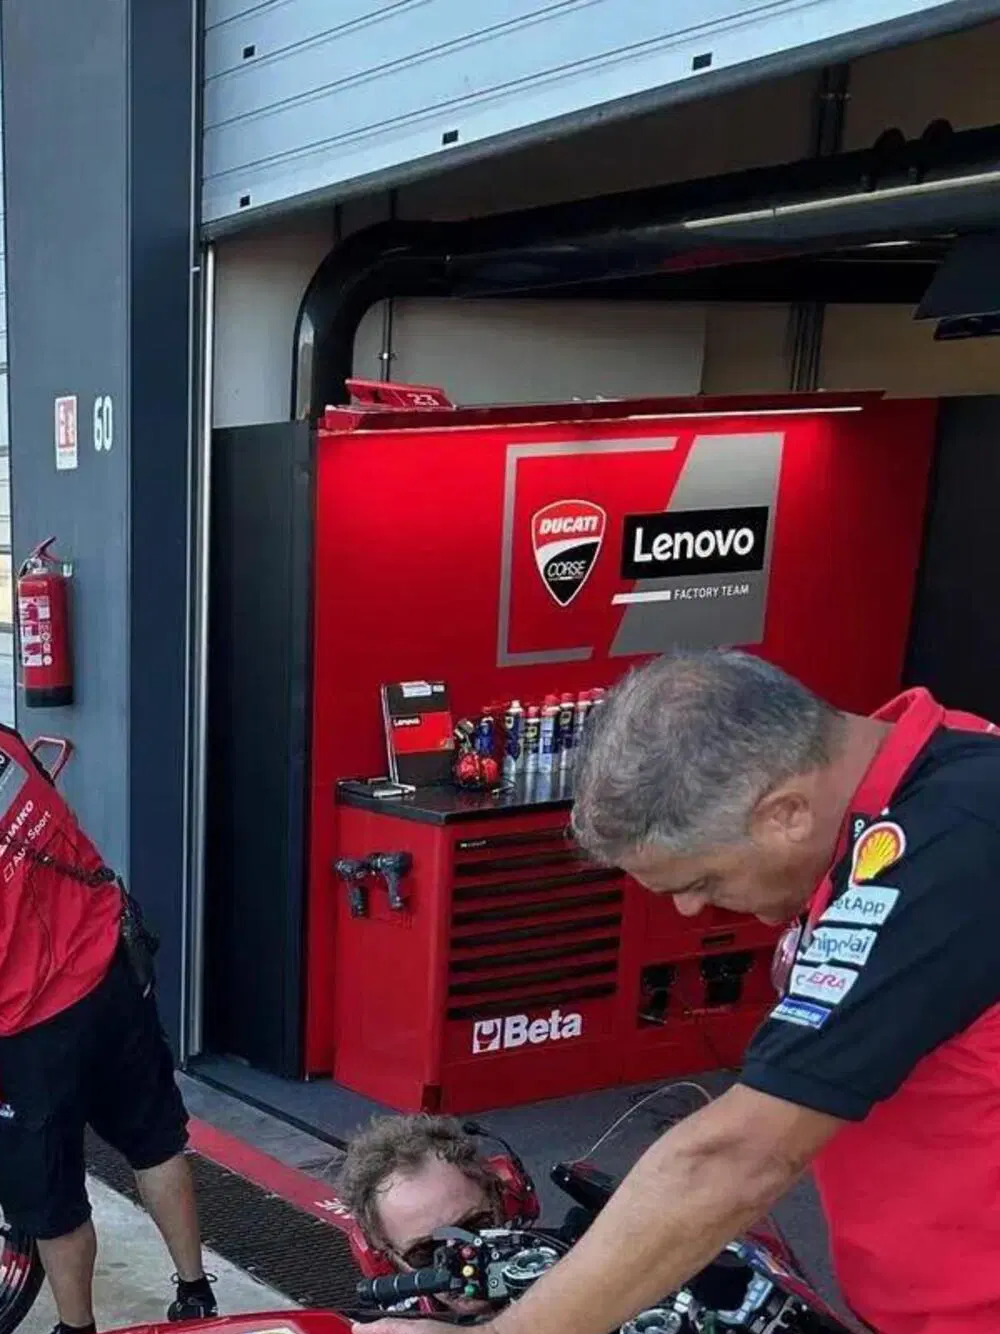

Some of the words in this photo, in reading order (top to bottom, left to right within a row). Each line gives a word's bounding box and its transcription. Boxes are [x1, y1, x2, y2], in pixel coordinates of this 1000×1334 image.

[94, 396, 113, 452] 60
[539, 515, 599, 535] DUCATI
[633, 526, 755, 563] Lenovo
[547, 560, 588, 578] CORSE
[673, 588, 719, 600] FACTORY
[722, 584, 750, 597] TEAM
[27, 810, 52, 841] Sport
[834, 896, 886, 918] etApp
[504, 1010, 583, 1049] Beta
